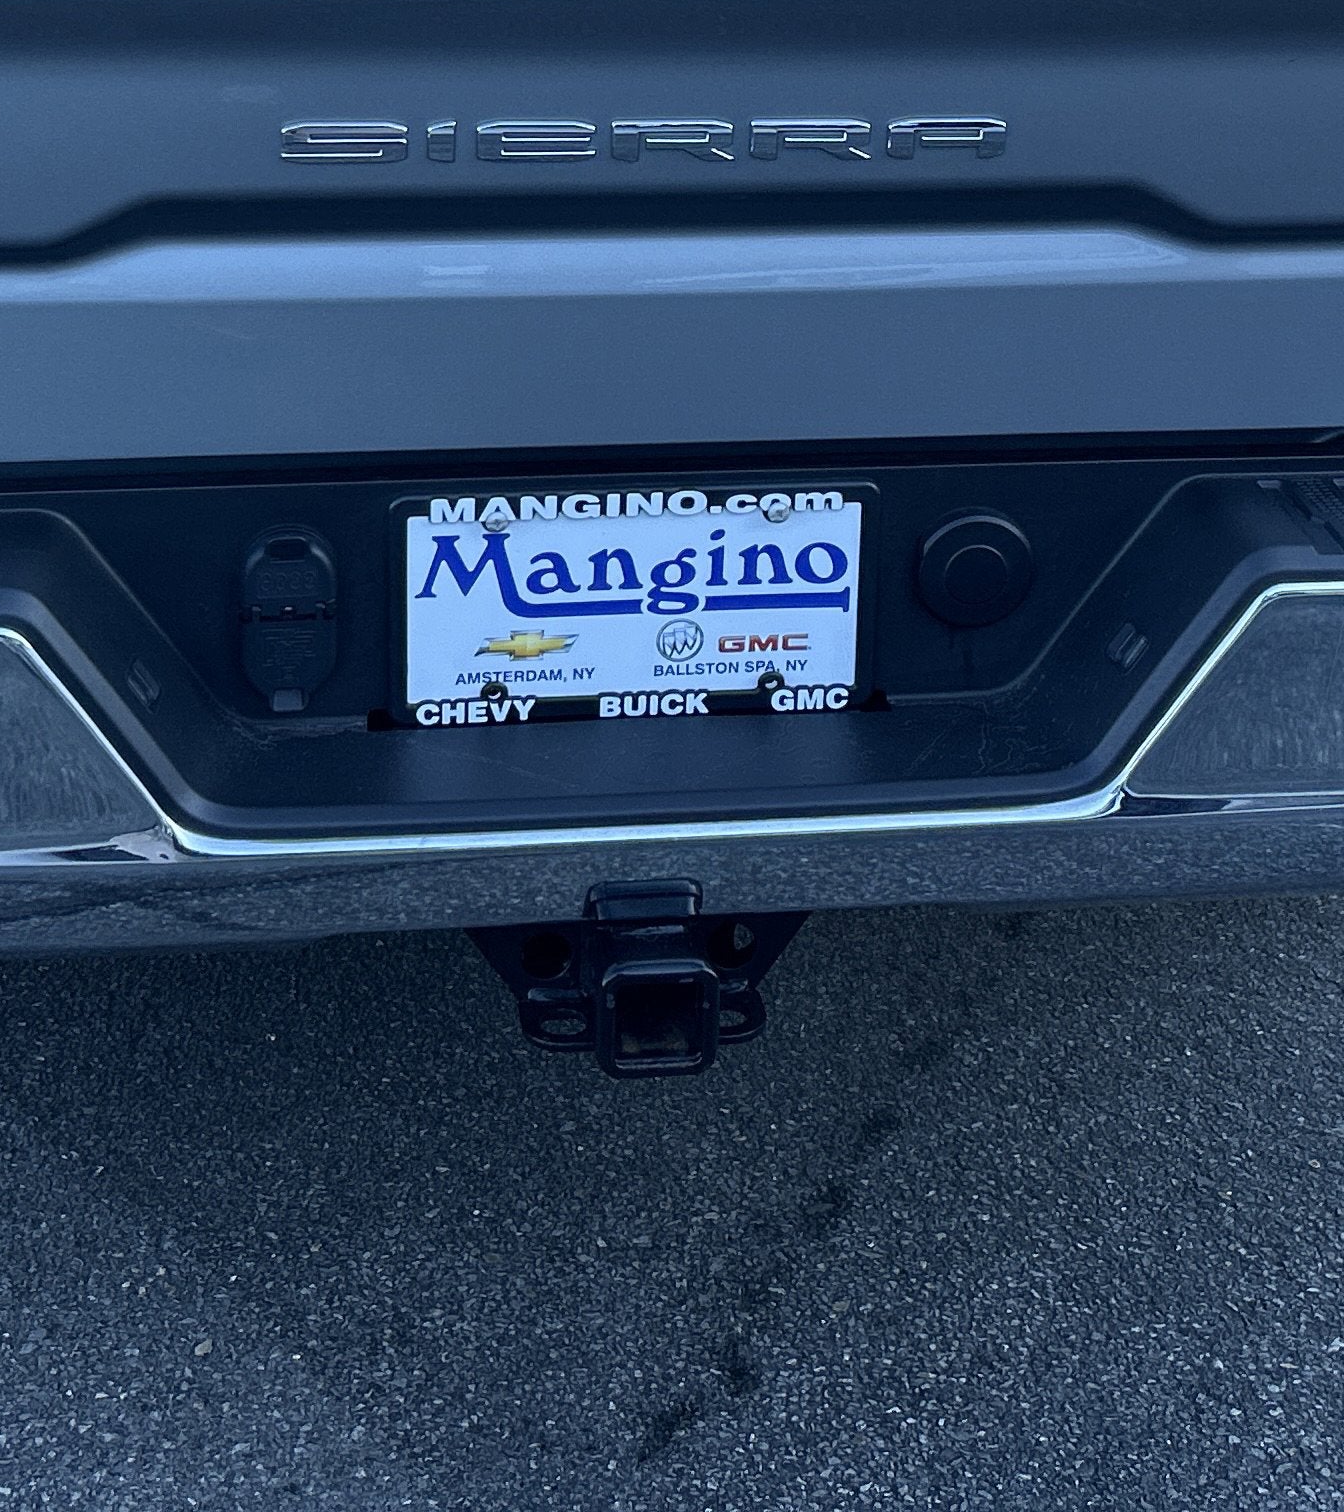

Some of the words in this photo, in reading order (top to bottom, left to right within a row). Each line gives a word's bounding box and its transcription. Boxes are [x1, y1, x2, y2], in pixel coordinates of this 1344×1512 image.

[279, 116, 1009, 163] SIERRA
[428, 489, 844, 523] MANGINO.com
[414, 528, 851, 618] Mangino
[718, 632, 811, 654] GMC
[455, 668, 568, 685] AMSTERDAM,
[572, 667, 596, 681] NY
[653, 661, 738, 677] BALLSTON
[744, 659, 780, 675] SPA,
[784, 658, 808, 673] NY
[415, 698, 536, 725] CHEVY
[599, 691, 709, 718] BUICK
[770, 687, 850, 711] GMC
